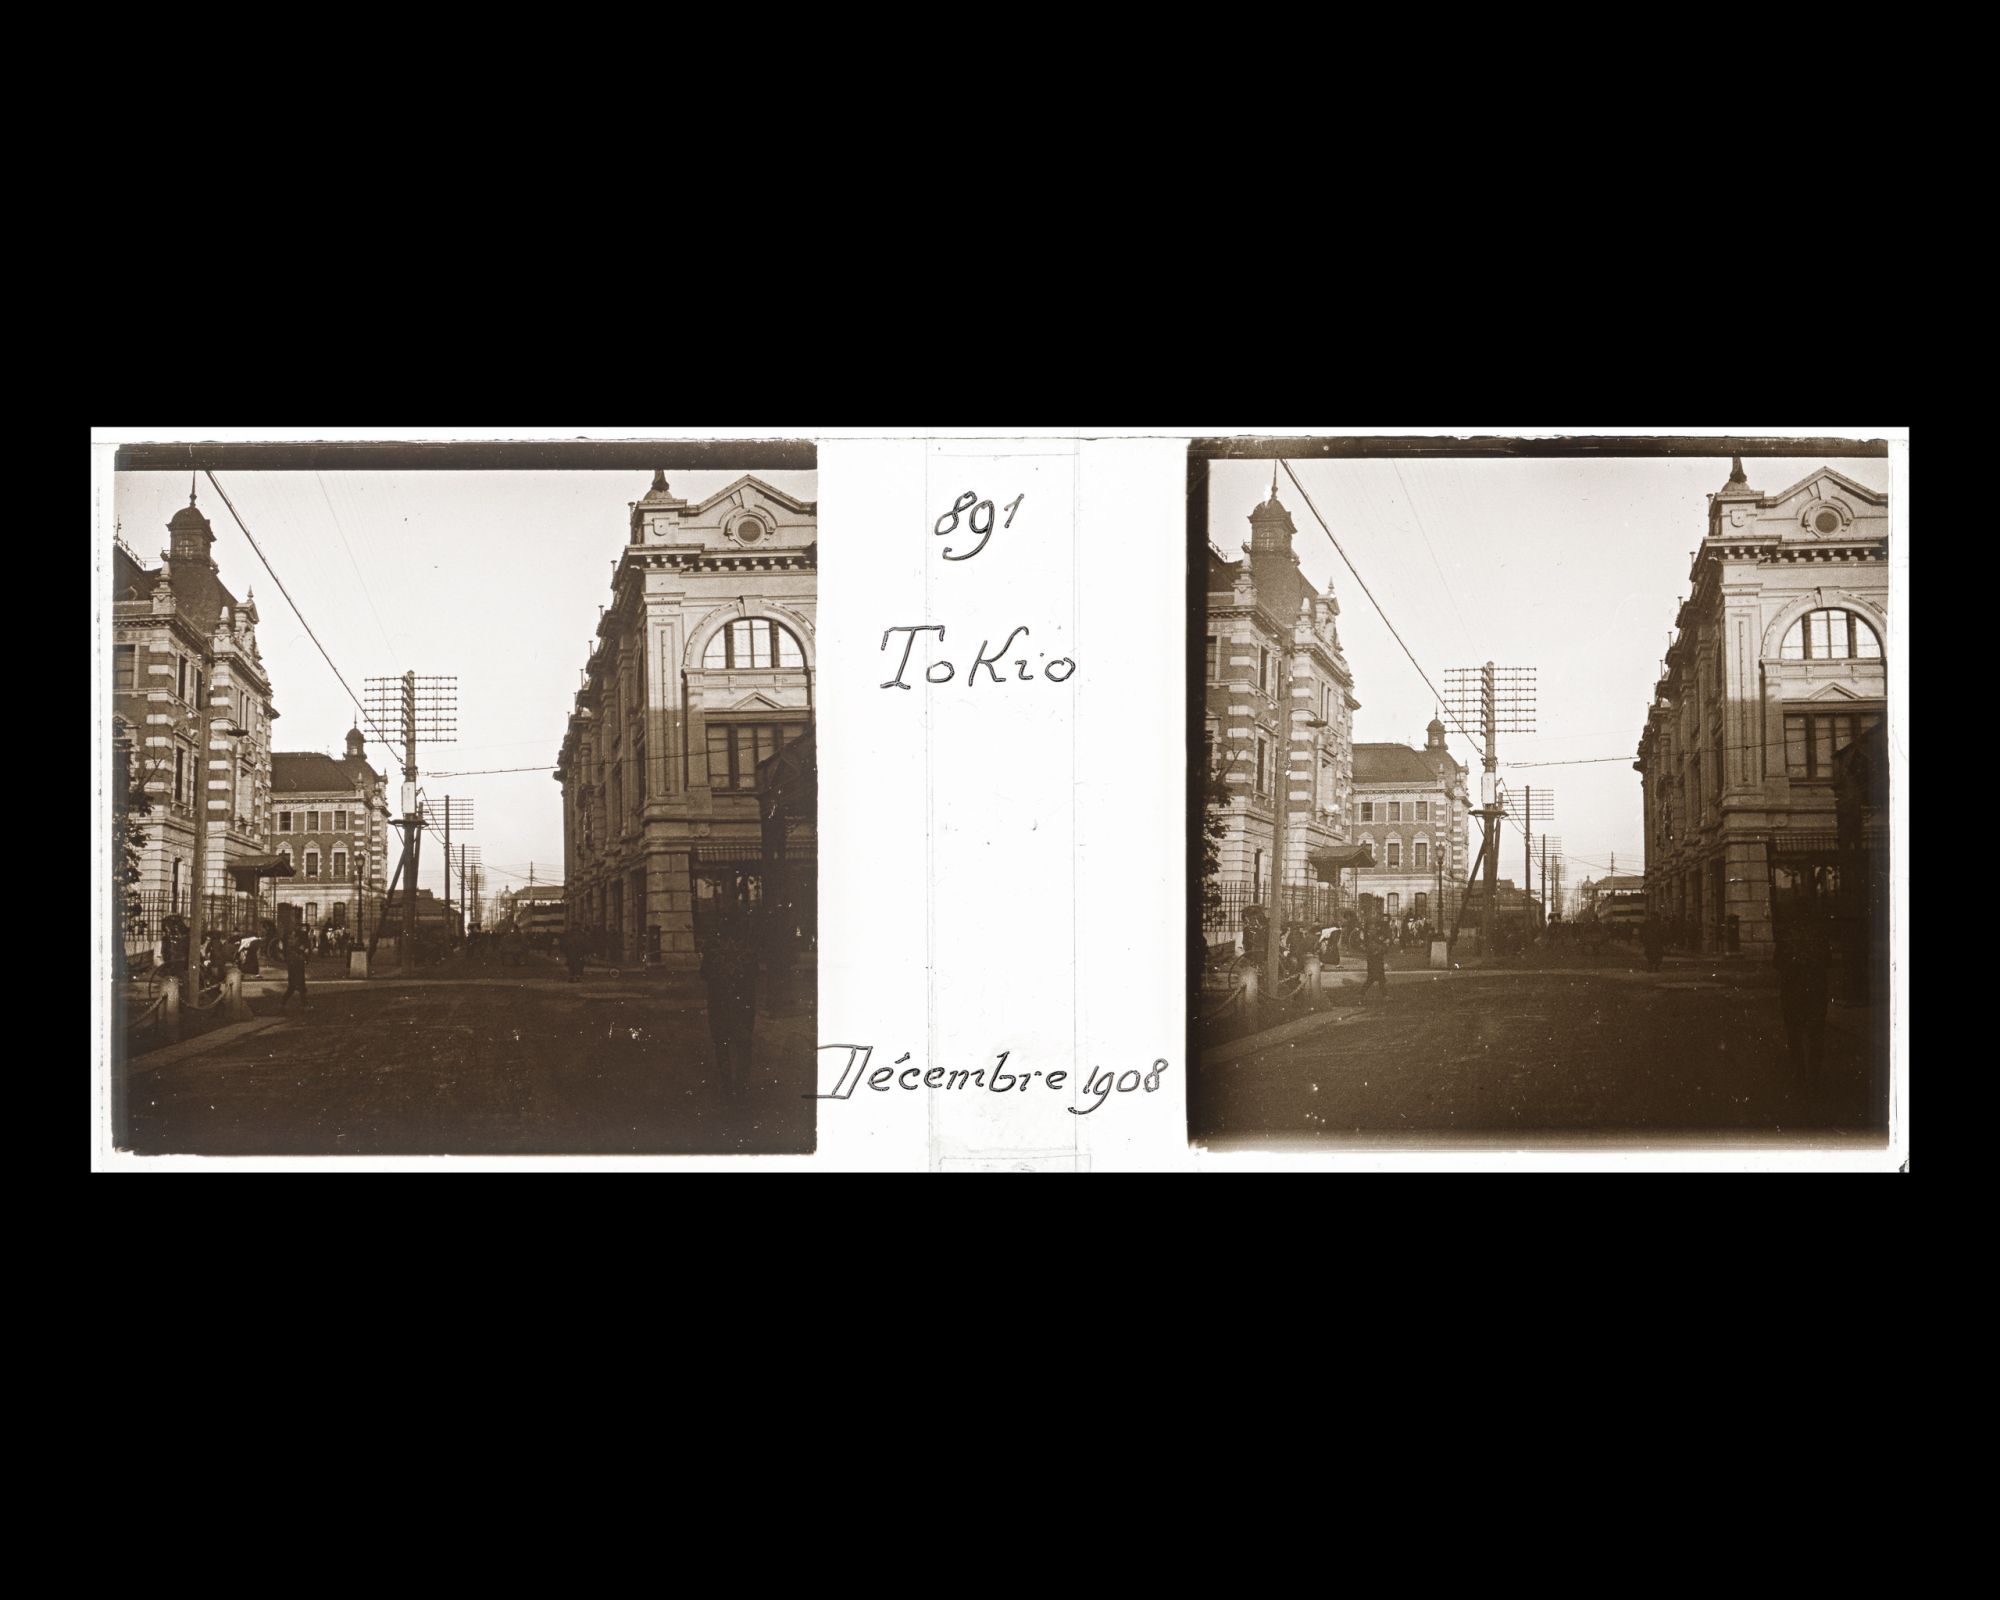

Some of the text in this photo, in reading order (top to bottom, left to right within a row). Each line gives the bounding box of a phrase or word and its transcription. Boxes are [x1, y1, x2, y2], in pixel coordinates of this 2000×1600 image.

[934, 490, 1024, 561] 891
[808, 1044, 1169, 1115] Décembre 1908
